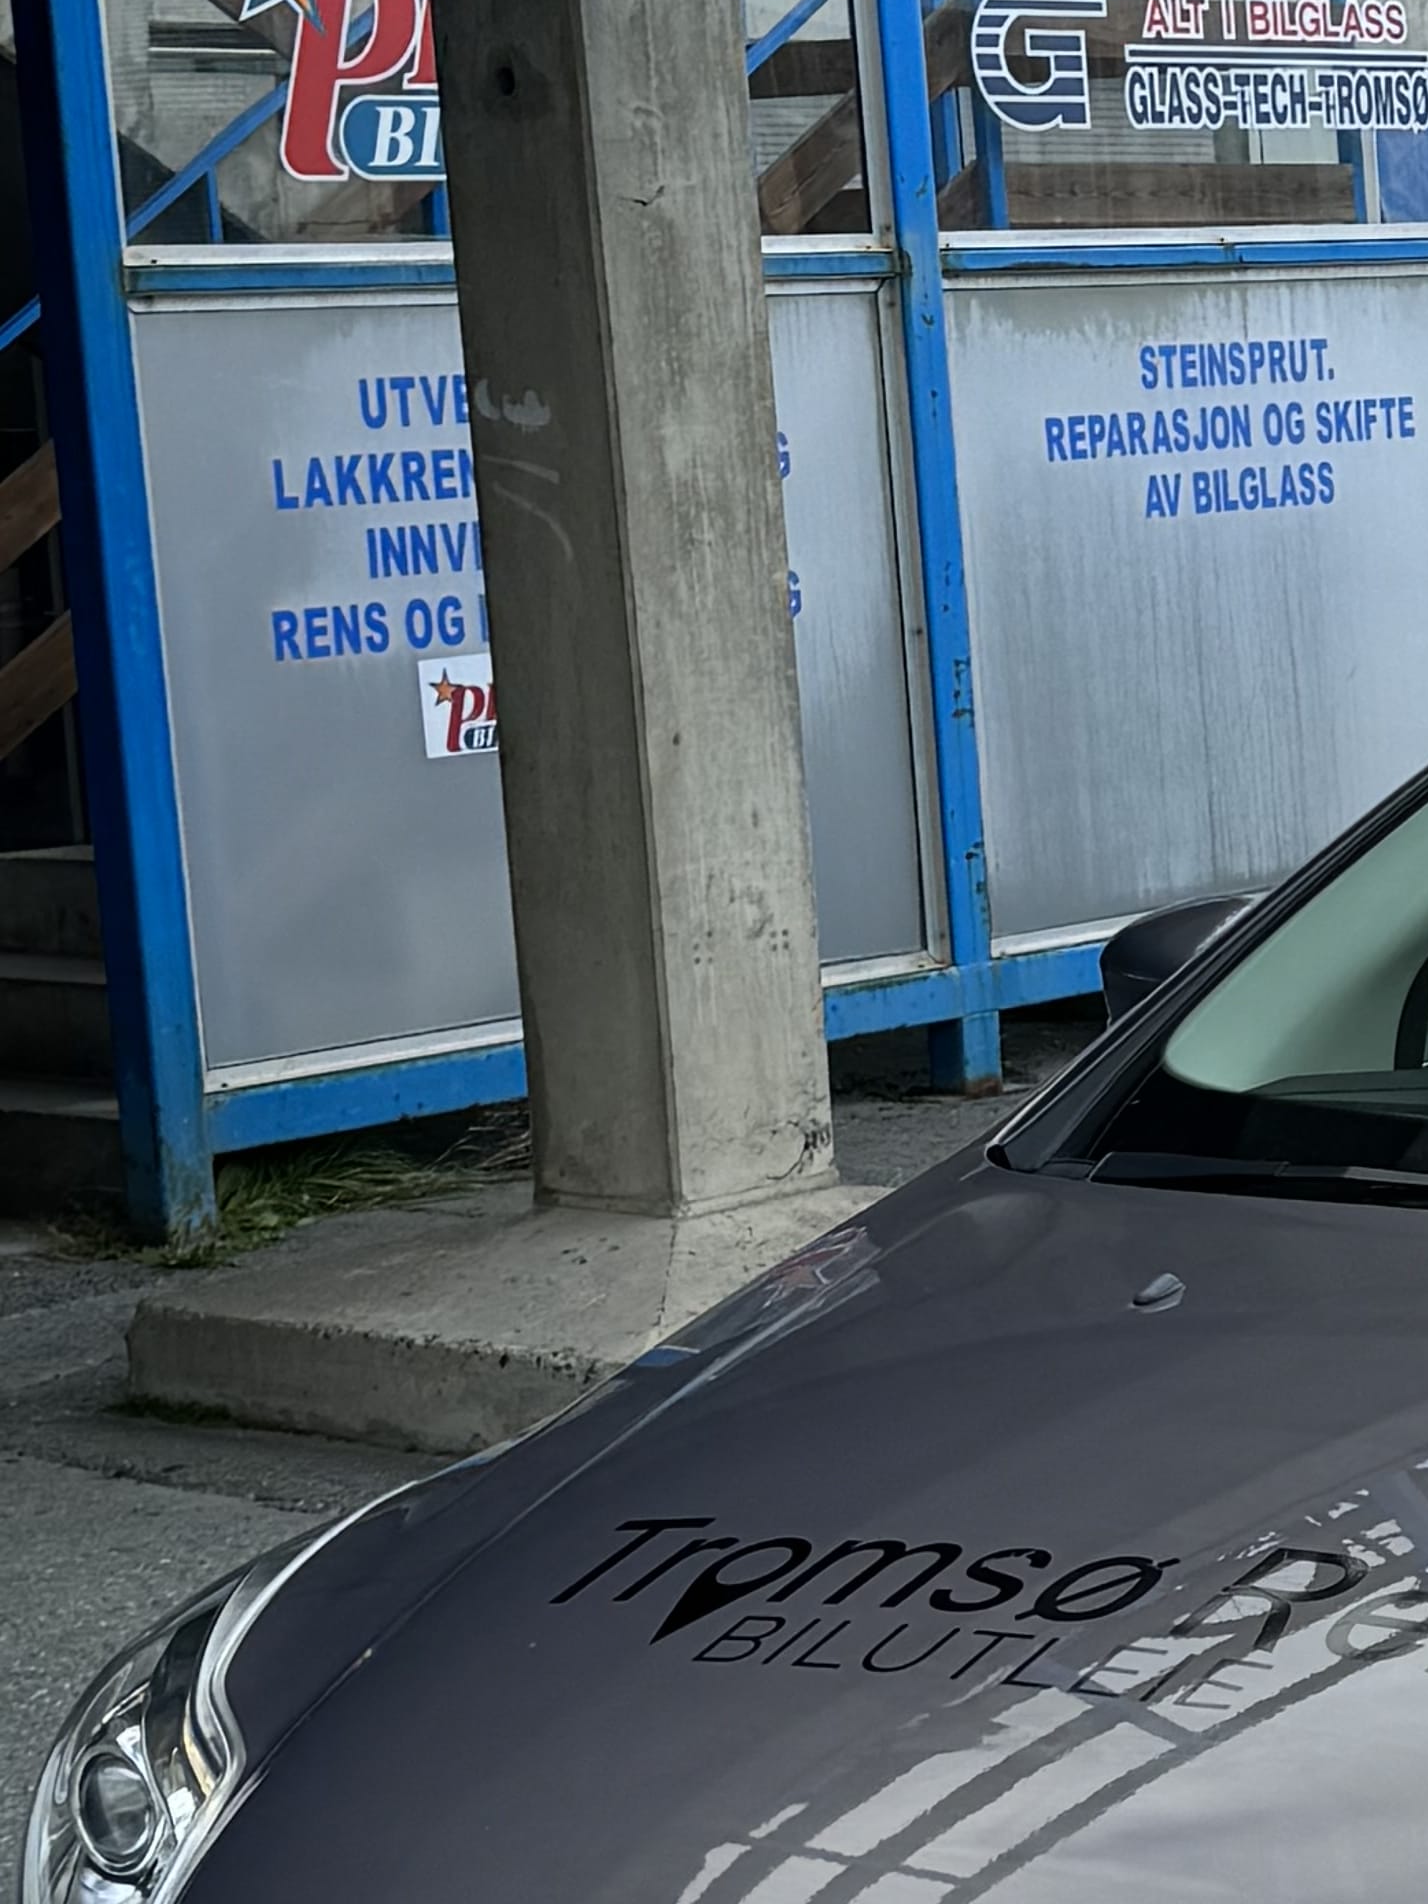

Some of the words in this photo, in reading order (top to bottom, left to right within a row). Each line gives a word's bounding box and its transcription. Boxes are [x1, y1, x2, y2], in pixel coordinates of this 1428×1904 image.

[1139, 338, 1335, 390] STEINSPRUT.
[1044, 404, 1253, 462] REPARASJON
[1263, 402, 1305, 446] OG
[1316, 396, 1416, 444] SKIFTE
[1145, 472, 1182, 519] AV
[1192, 462, 1336, 515] BILGLASS
[271, 602, 390, 662] RENS
[405, 596, 466, 650] OG
[549, 1516, 1182, 1645] Tromsø
[690, 1615, 1279, 1711] BILUTLEIE
